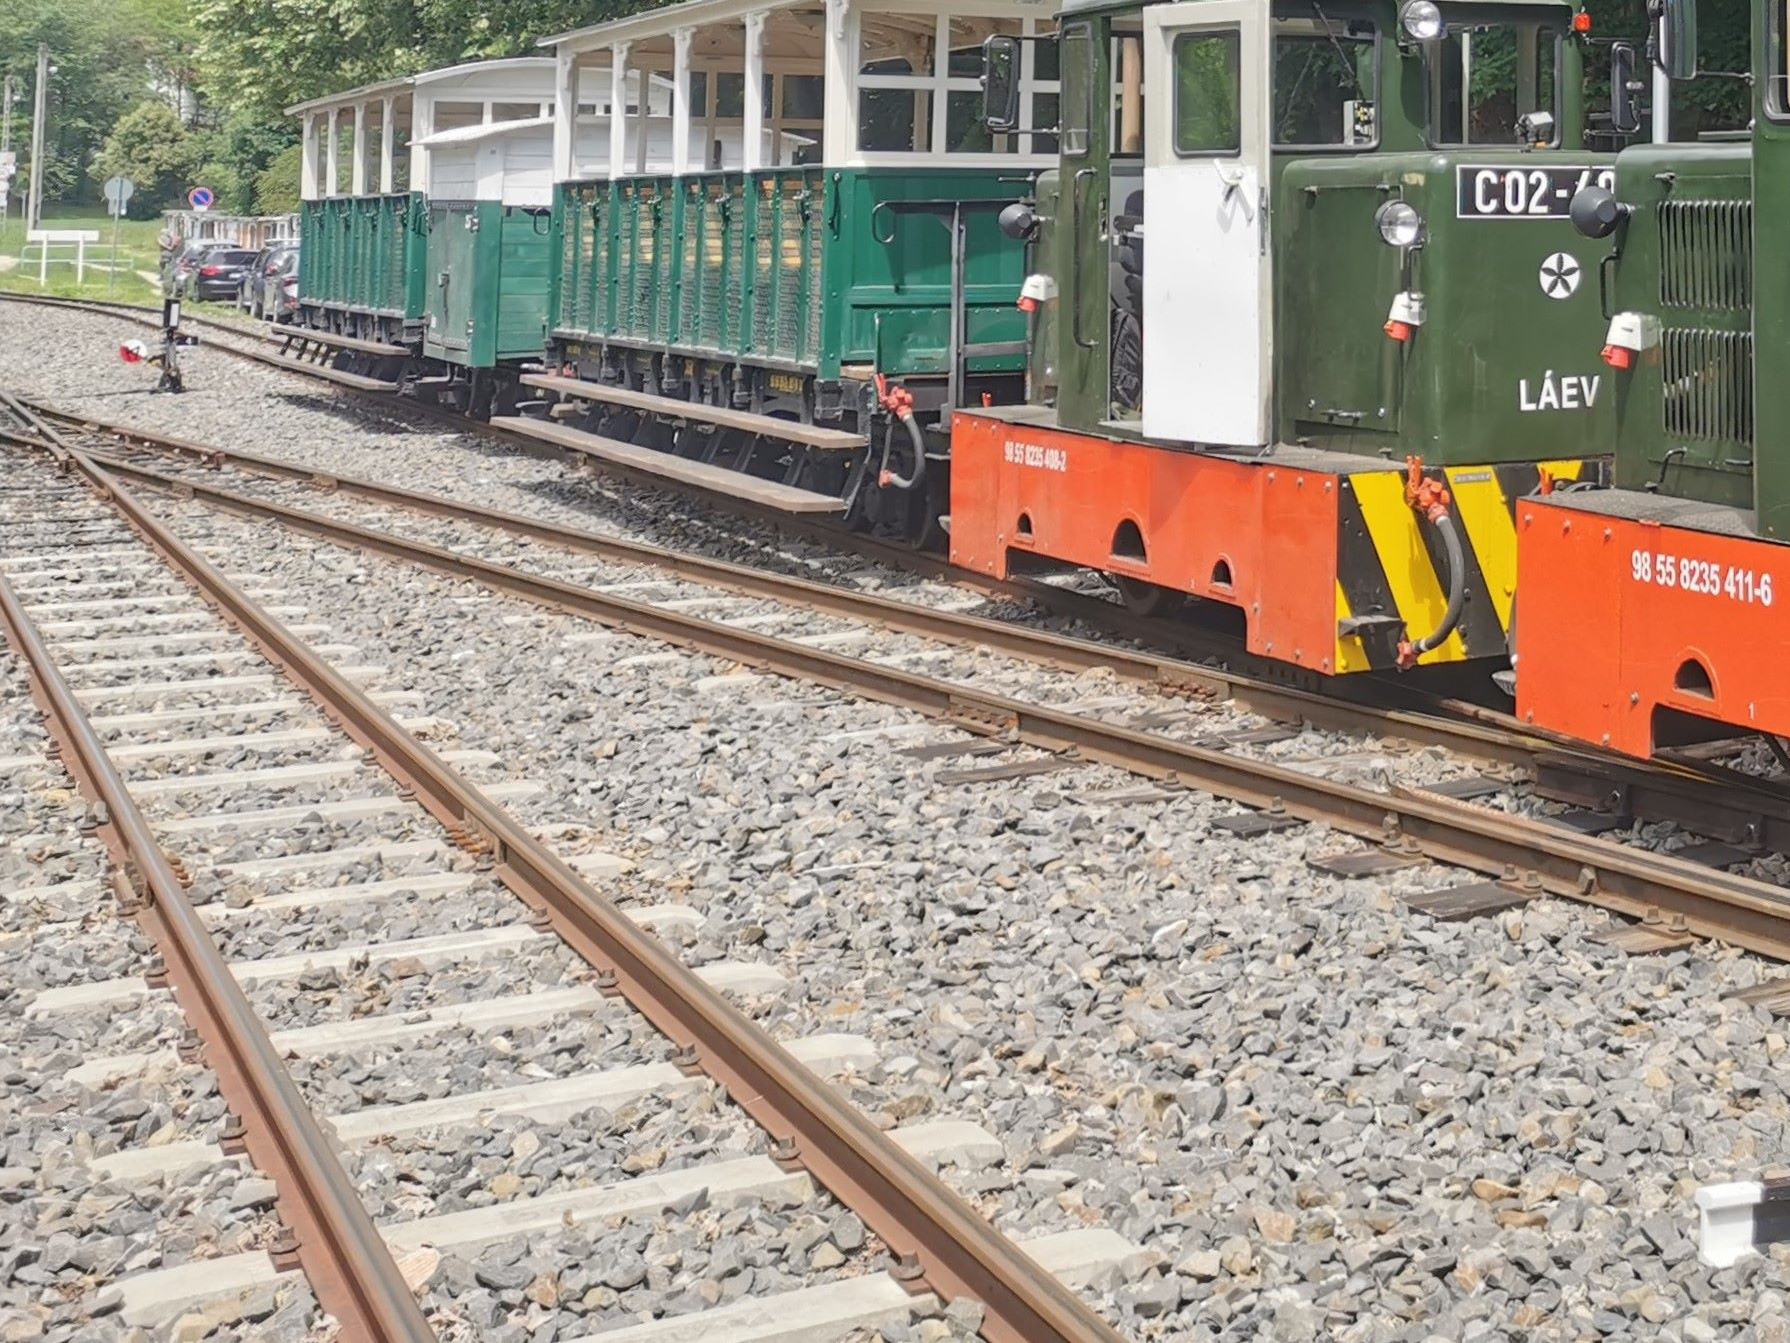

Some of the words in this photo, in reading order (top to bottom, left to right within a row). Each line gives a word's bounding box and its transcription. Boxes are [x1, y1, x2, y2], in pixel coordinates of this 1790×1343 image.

[1519, 369, 1600, 412] LÁEV
[1631, 549, 1652, 583] 98
[1655, 553, 1676, 587] 55
[1679, 557, 1721, 596] 8235
[1724, 566, 1773, 607] 411-6
[1748, 702, 1755, 721] 1
